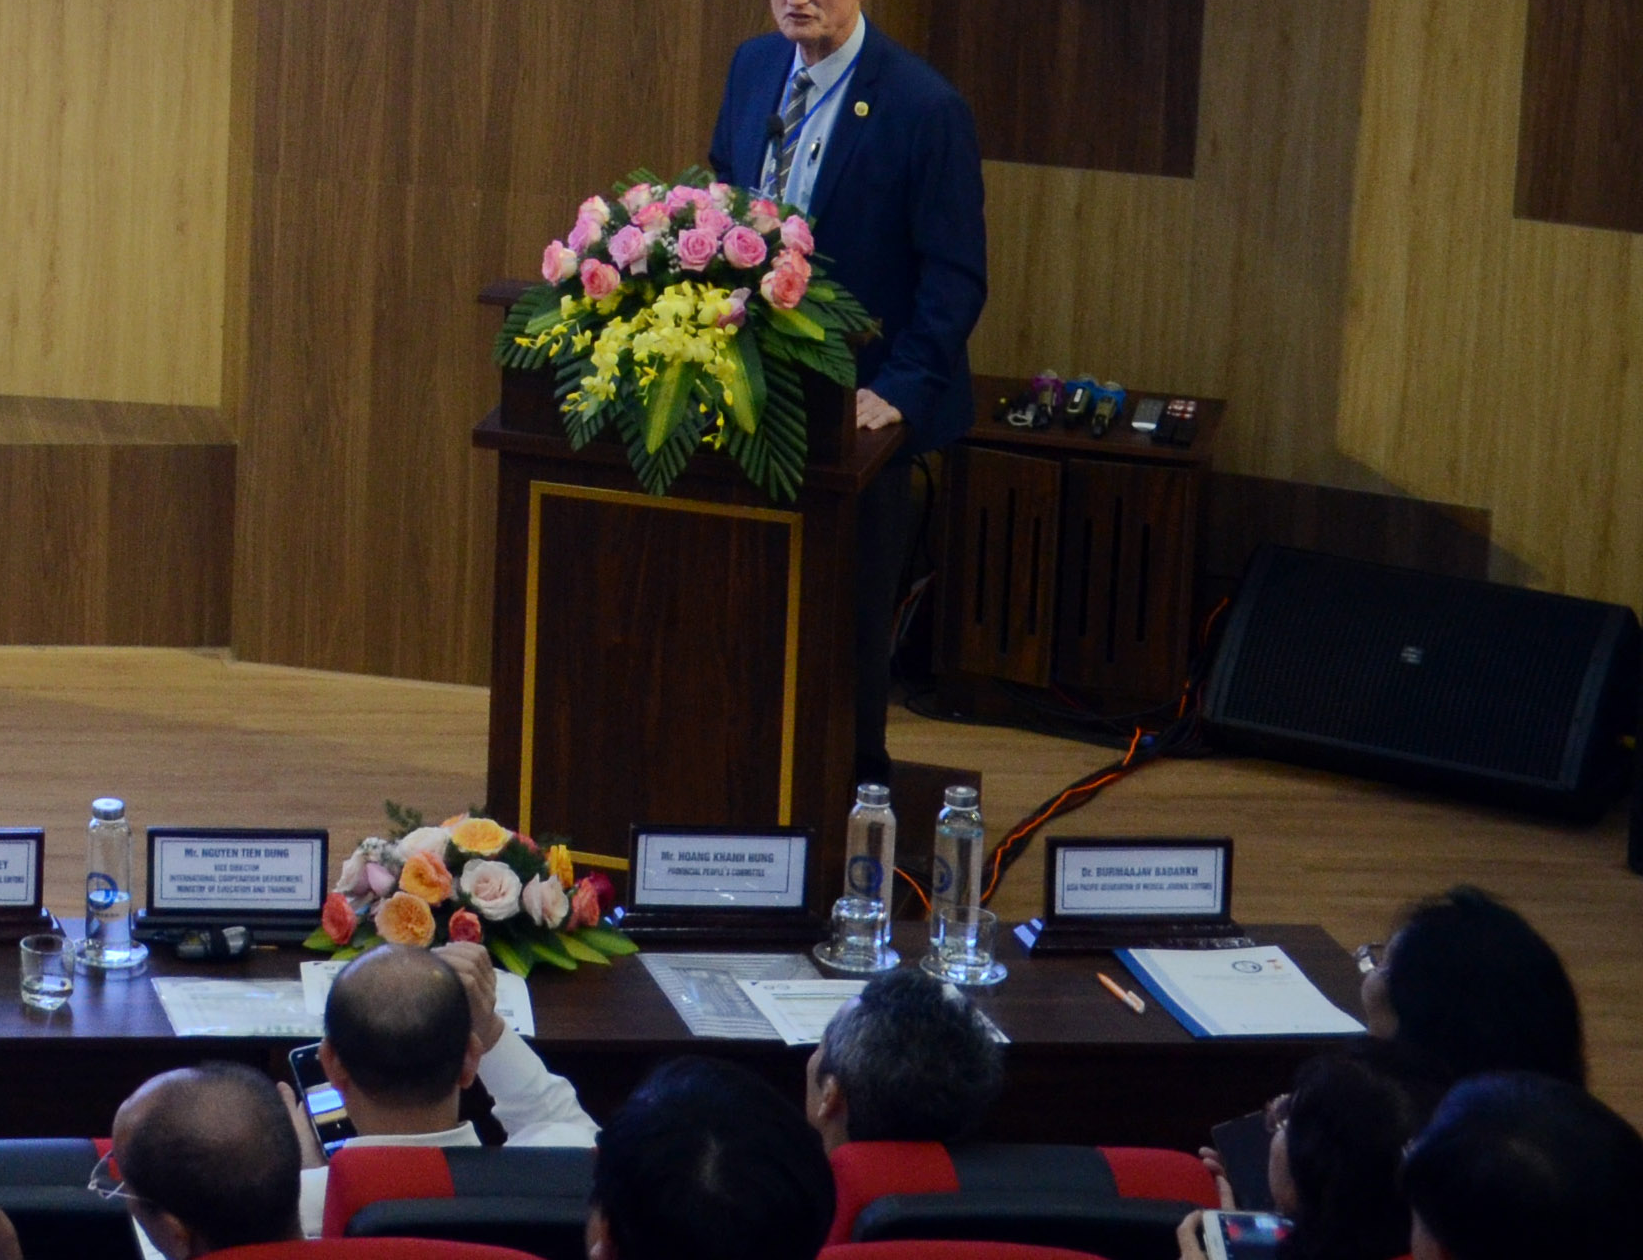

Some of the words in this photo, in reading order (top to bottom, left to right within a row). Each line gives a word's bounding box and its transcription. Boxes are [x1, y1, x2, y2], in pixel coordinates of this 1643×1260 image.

[184, 848, 199, 858] Mr.
[201, 848, 239, 858] NGUYEN
[241, 848, 262, 858] TIEN
[264, 848, 289, 858] DUNG
[661, 851, 675, 861] Mr.
[678, 852, 710, 862] HOANG
[713, 852, 745, 863] KHANH
[748, 852, 774, 863] HUNG
